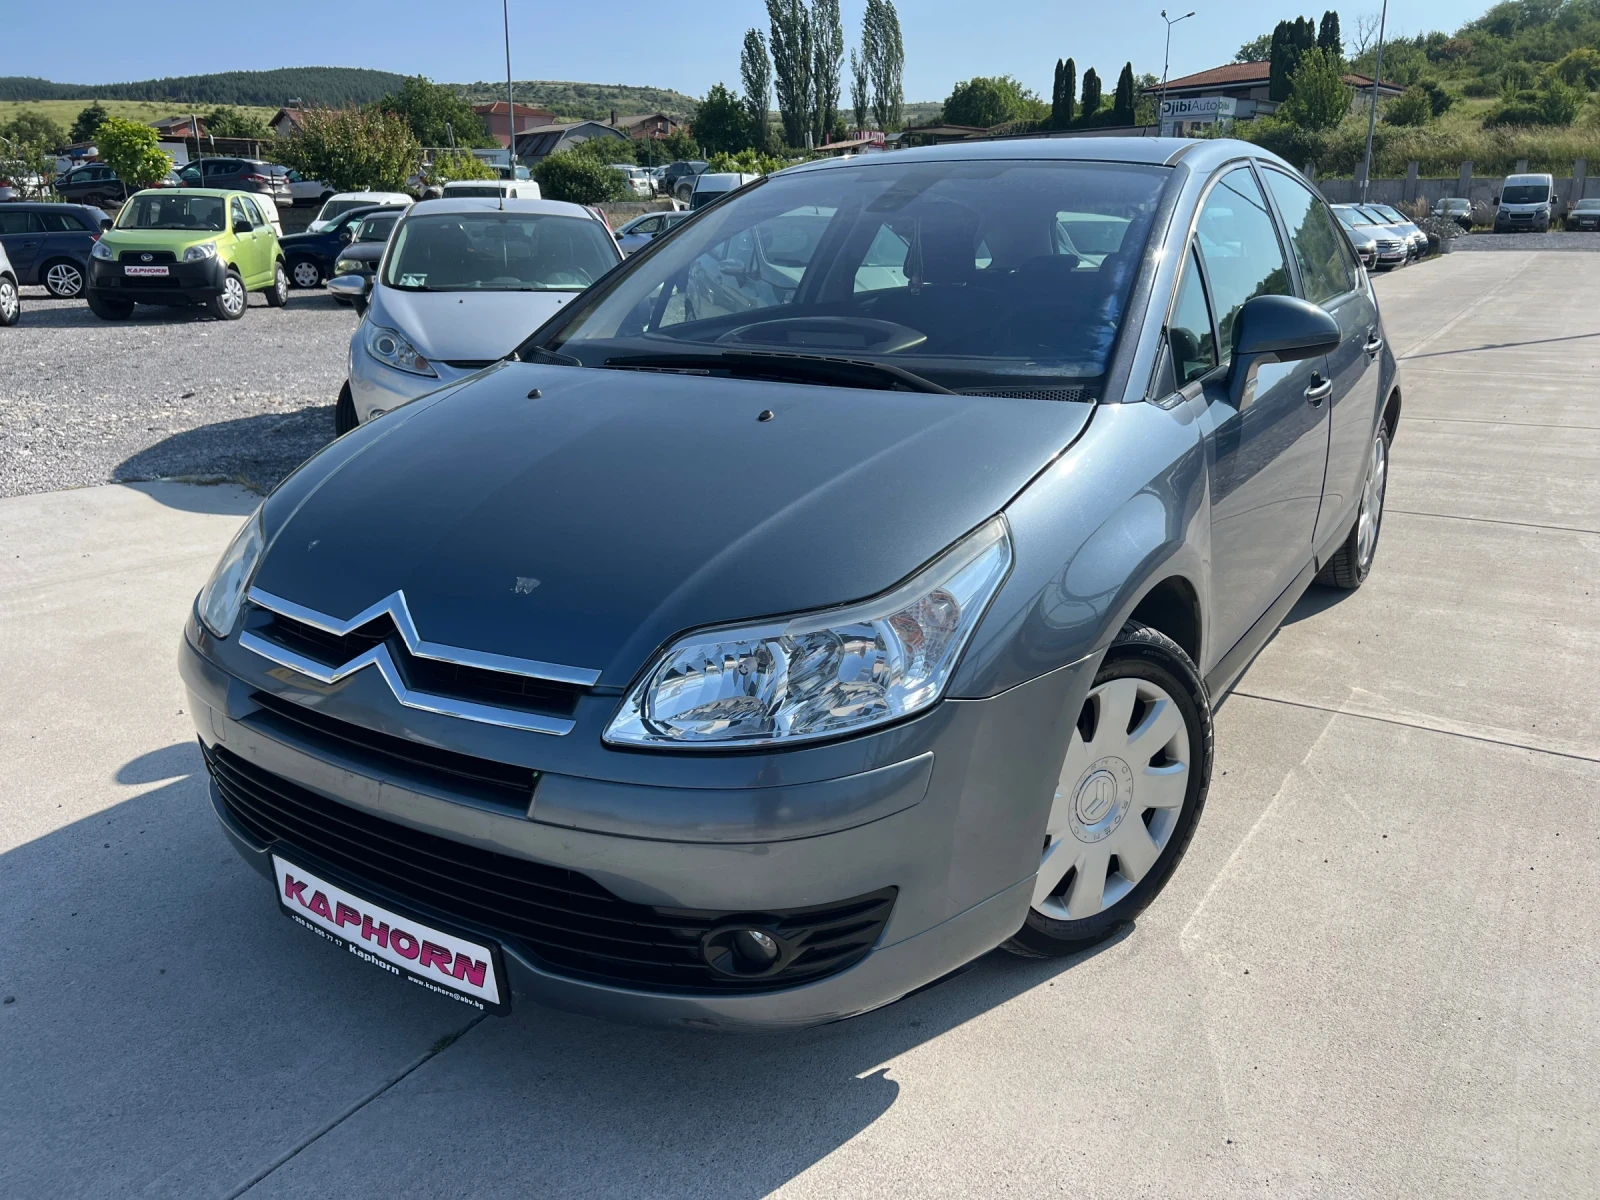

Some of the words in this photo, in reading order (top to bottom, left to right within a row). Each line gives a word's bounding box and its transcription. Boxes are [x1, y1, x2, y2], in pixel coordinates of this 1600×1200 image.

[1163, 100, 1218, 115] DjibiAuto
[285, 873, 487, 988] KAPHORN
[349, 943, 400, 975] Kaphorn
[408, 975, 484, 1010] www.kaphorn@abv.bg
